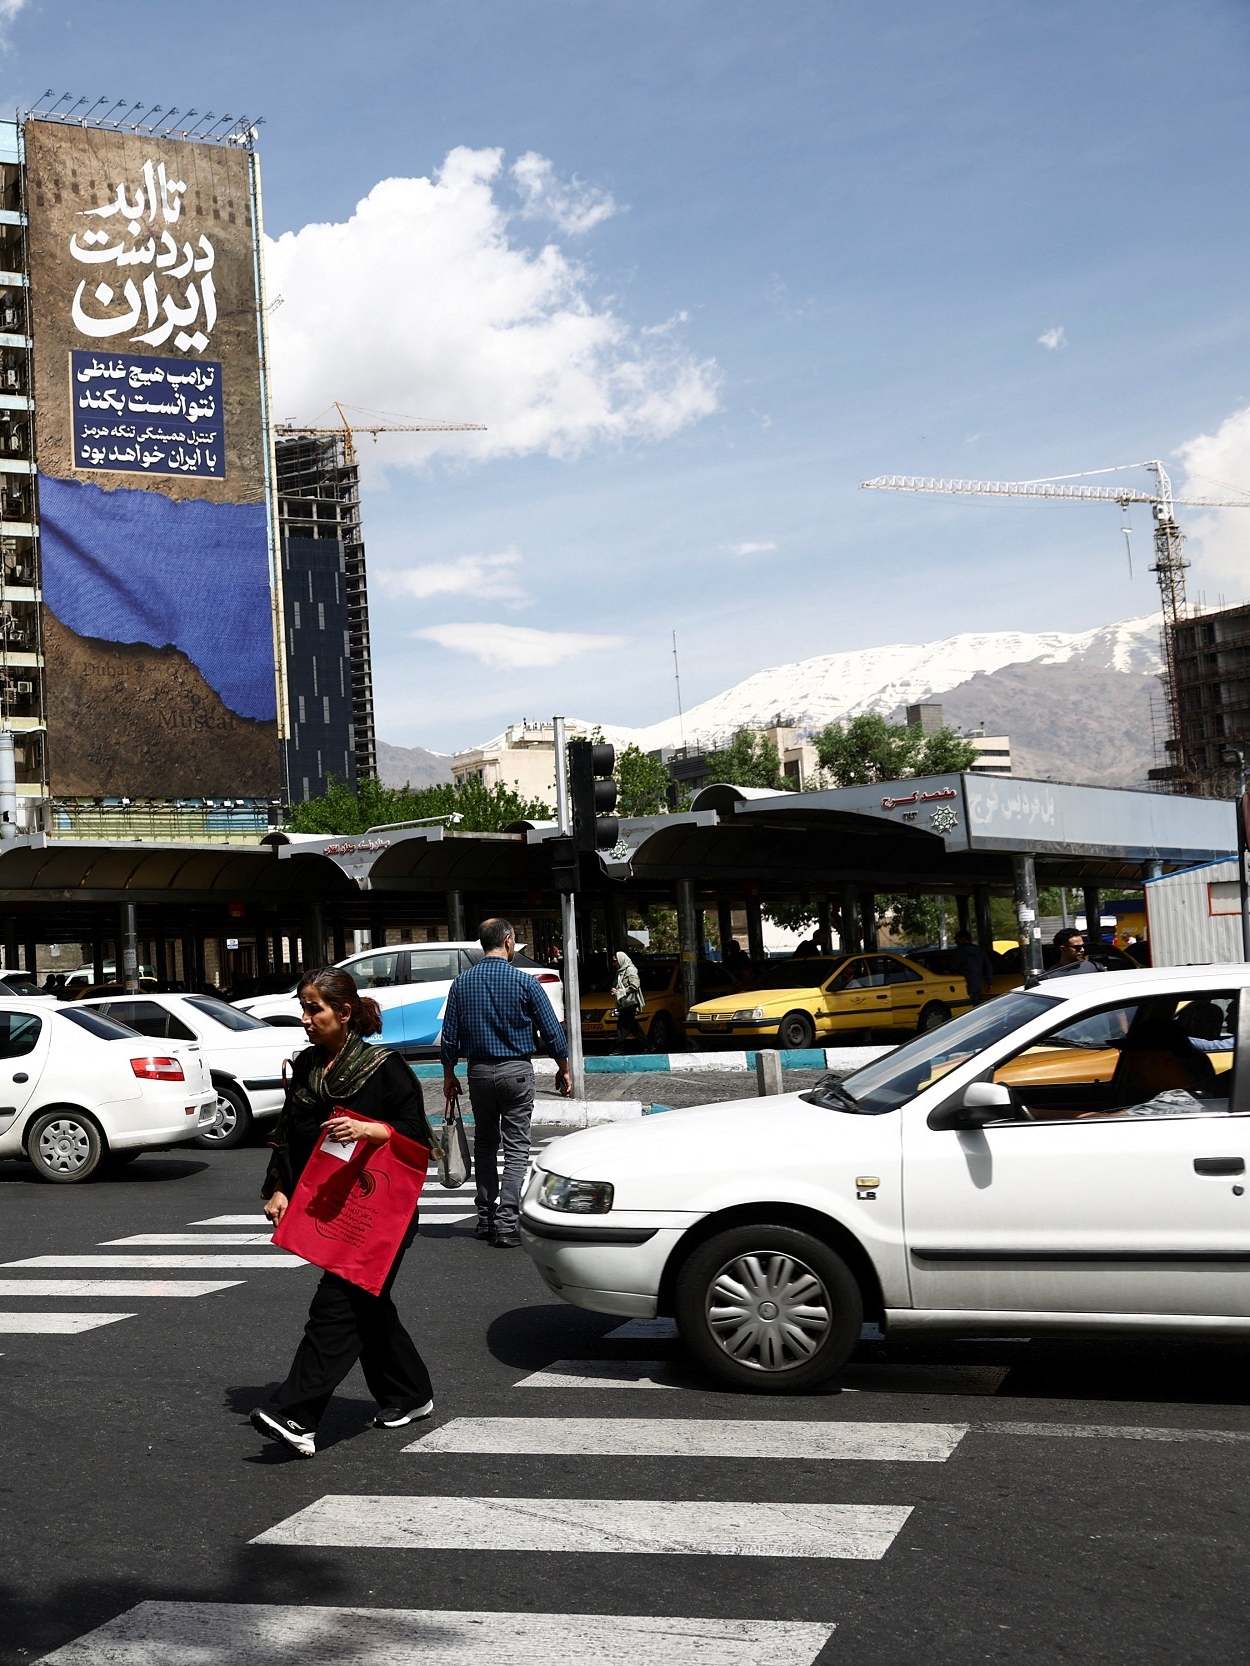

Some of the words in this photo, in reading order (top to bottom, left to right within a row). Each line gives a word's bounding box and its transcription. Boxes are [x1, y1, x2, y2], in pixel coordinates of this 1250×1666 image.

[76, 158, 156, 236] ابد
[158, 161, 187, 224] تا
[69, 230, 178, 268] دست
[162, 233, 215, 278] در
[71, 271, 218, 354] ایران
[77, 358, 127, 382] غلطی
[128, 365, 165, 388] هیچ
[166, 366, 215, 391] ترامپ
[79, 389, 126, 416] بکند
[128, 392, 216, 423] نتوانست
[81, 424, 109, 438] هرمز
[110, 425, 136, 438] تنگه
[136, 426, 186, 443] همیشگی
[186, 430, 217, 445] کنترل
[81, 444, 106, 465] بود
[108, 443, 166, 468] خواهد
[168, 446, 202, 471] ایران
[205, 449, 217, 472] با
[83, 662, 130, 677] Dubai
[155, 709, 237, 731] Muscat
[881, 790, 919, 808] کرج
[920, 787, 957, 801] مقصد
[969, 782, 998, 824] کرج
